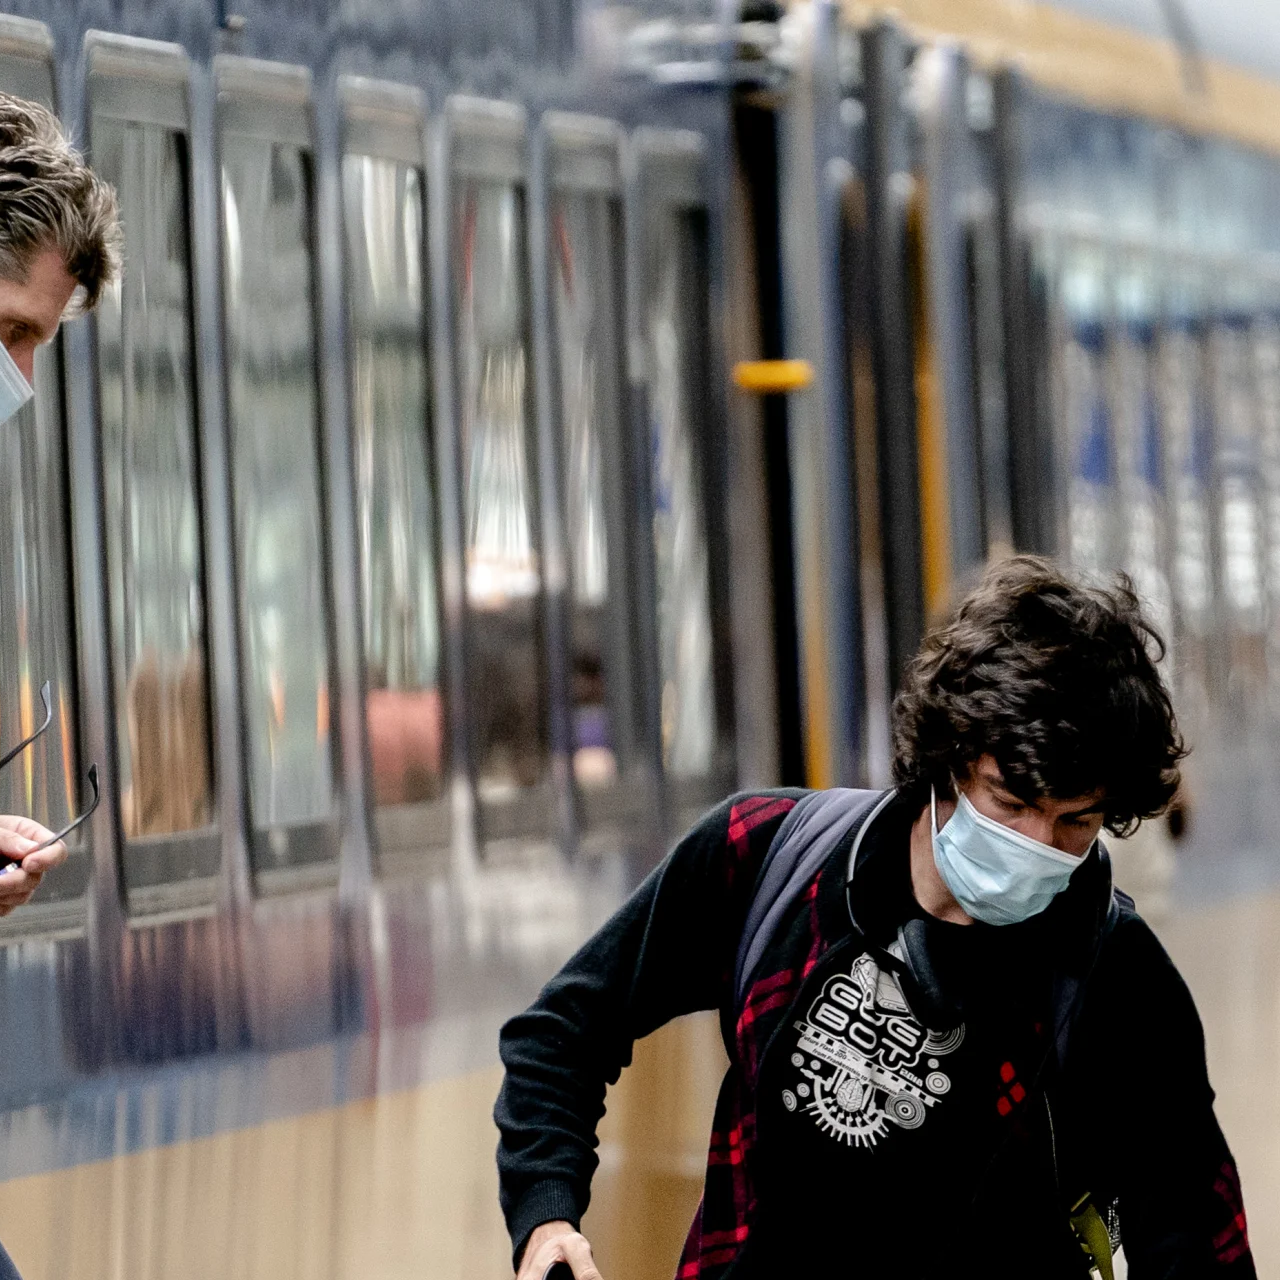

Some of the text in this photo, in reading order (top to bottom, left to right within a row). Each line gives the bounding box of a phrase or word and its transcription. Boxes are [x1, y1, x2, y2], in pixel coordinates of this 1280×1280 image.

[815, 1002, 911, 1062] BOT
[812, 1048, 827, 1058] from
[826, 1056, 861, 1077] Frankenstein
